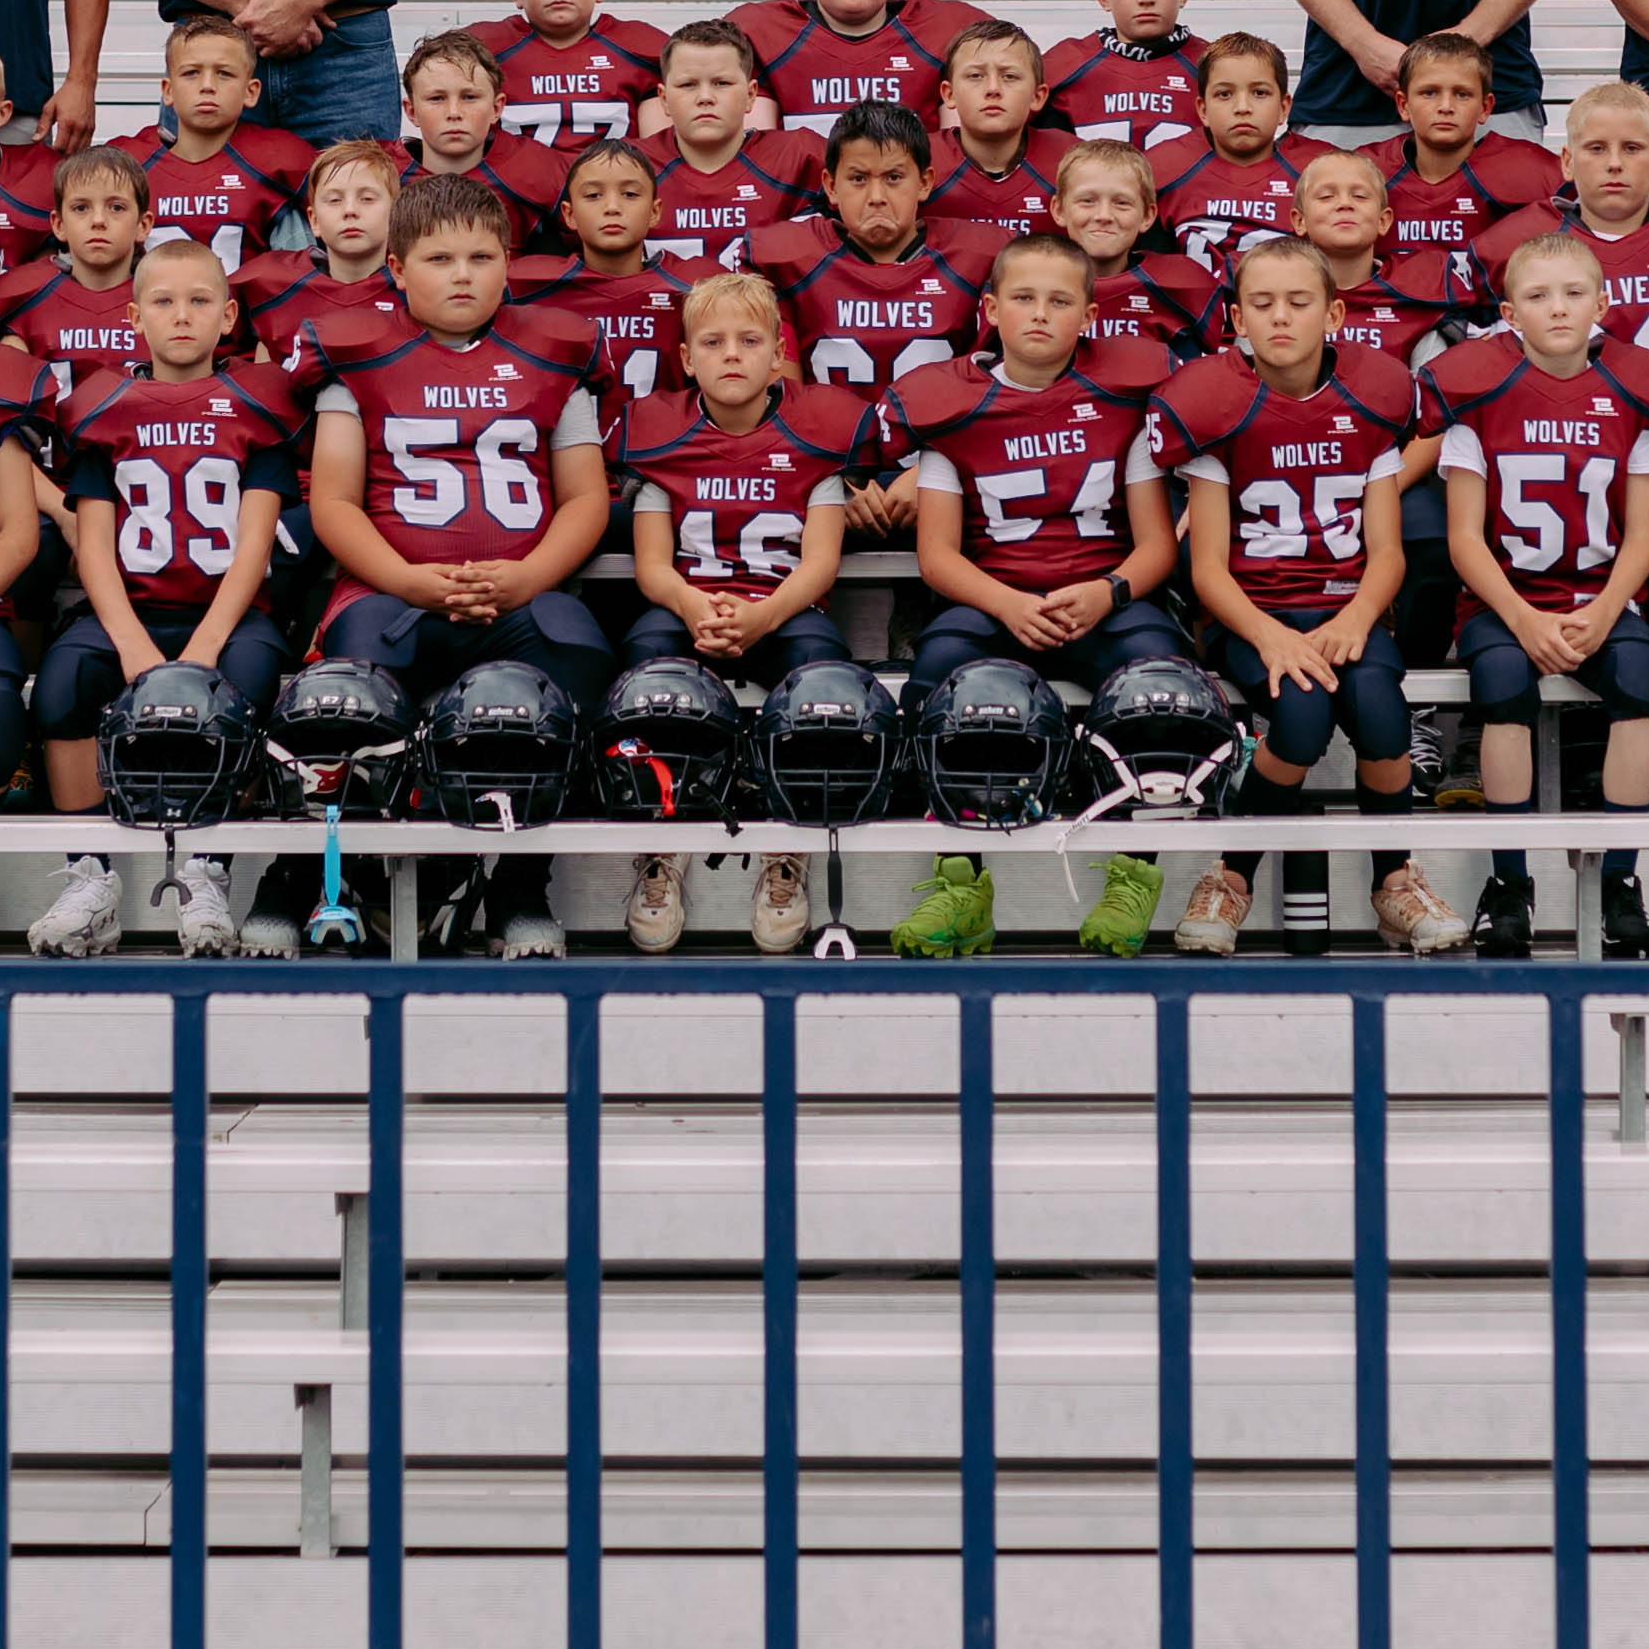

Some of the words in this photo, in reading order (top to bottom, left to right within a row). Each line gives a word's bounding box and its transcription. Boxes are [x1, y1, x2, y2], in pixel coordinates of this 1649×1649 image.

[531, 73, 600, 95] WOLVES
[811, 77, 901, 105] WOLVES
[1103, 91, 1174, 114] WOLVES
[157, 195, 230, 217] WOLVES
[676, 207, 746, 230] WOLVES
[1207, 198, 1277, 222] WOLVES
[1397, 219, 1464, 242] WOLVES
[836, 300, 934, 329] WOLVES
[59, 328, 136, 352] WOLVES
[423, 385, 509, 410] WOLVES
[135, 422, 217, 448] WOLVES
[1003, 429, 1087, 462] WOLVES
[1523, 419, 1601, 447] WOLVES
[1271, 441, 1343, 469] WOLVES
[383, 416, 544, 531] 56
[695, 476, 776, 502] WOLVES
[973, 459, 1116, 543] 54
[114, 457, 242, 576] 89
[1496, 454, 1617, 572] 51
[676, 511, 805, 580] 16
